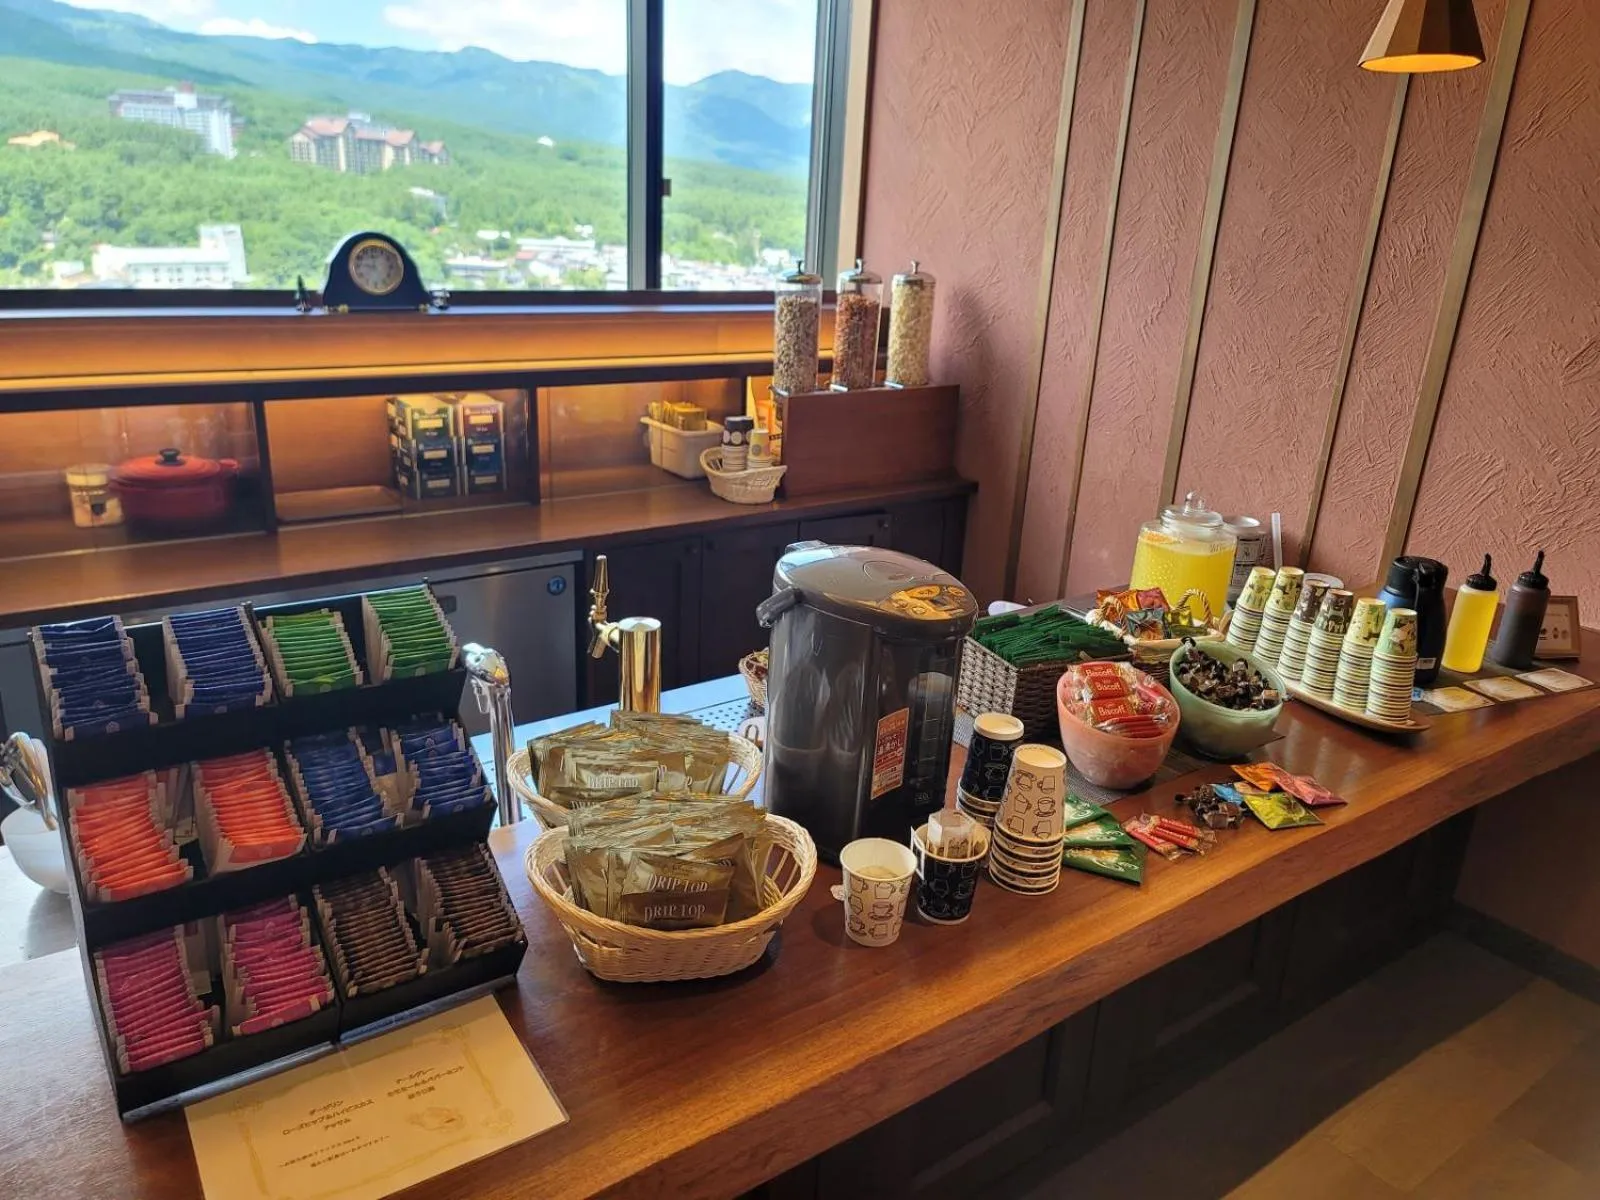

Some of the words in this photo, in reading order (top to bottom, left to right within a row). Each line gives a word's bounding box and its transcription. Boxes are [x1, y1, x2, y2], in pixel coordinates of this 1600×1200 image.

[1096, 683, 1121, 692] Biscoff
[1098, 705, 1126, 716] Biscoff
[646, 873, 680, 893] DRIP
[643, 904, 677, 924] DRIP
[681, 904, 706, 920] TOP
